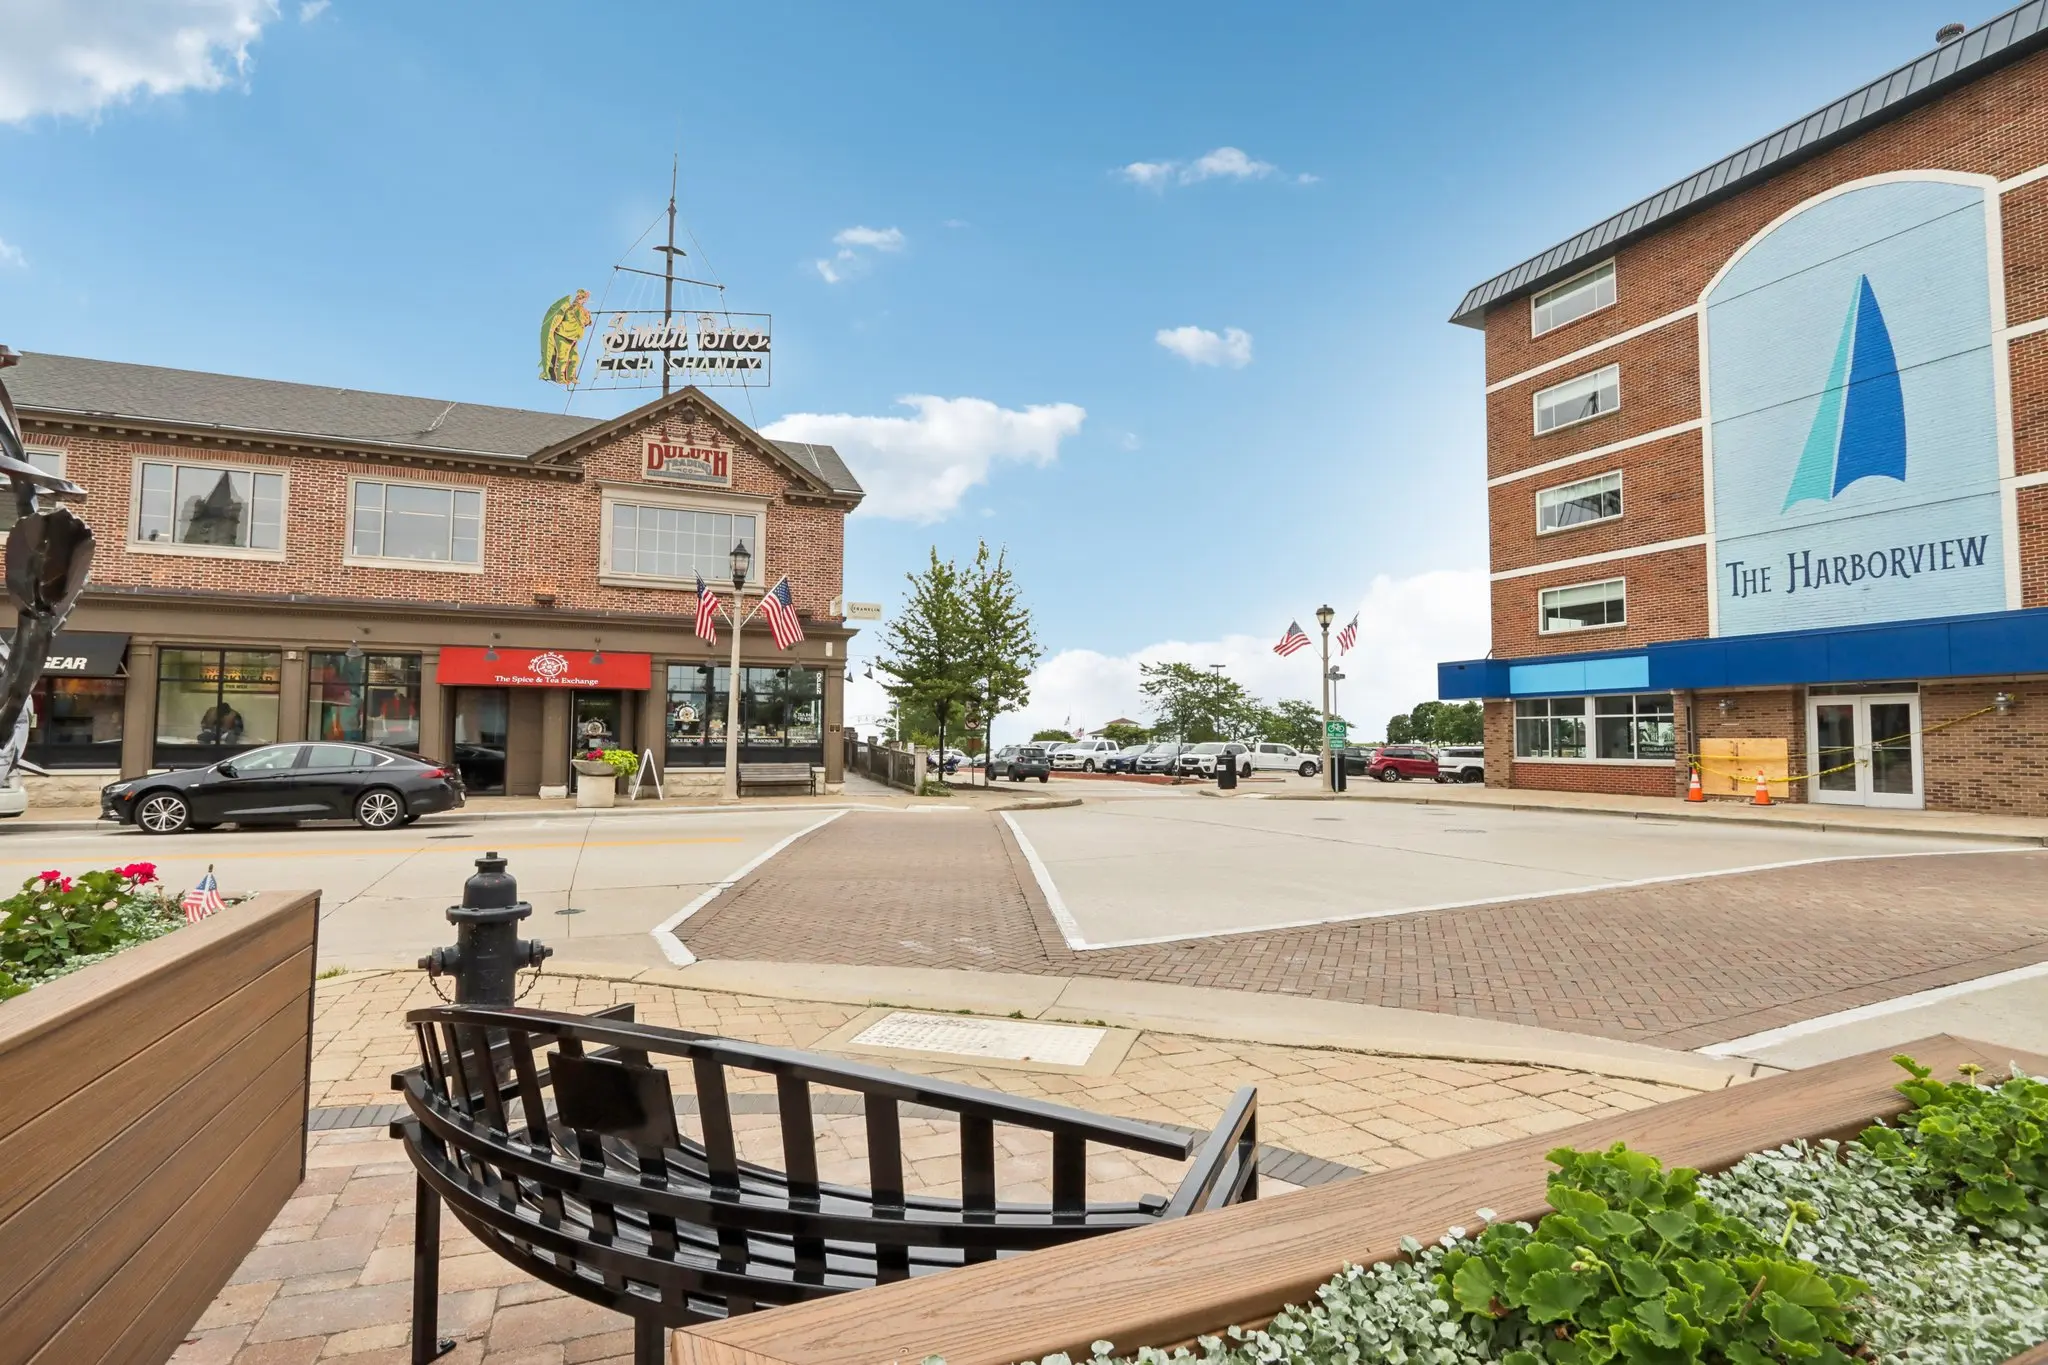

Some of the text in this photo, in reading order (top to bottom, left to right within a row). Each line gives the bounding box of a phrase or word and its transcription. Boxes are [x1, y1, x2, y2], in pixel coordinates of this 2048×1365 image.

[602, 313, 772, 353] Smith Bros.
[597, 355, 762, 379] FISH SHANTY
[648, 443, 728, 477] DULUTH
[664, 459, 712, 475] TRADING
[1726, 534, 1989, 598] THE HARBORVIEW
[495, 675, 510, 683] The
[512, 675, 534, 685] Spice
[561, 677, 599, 686] Exchange
